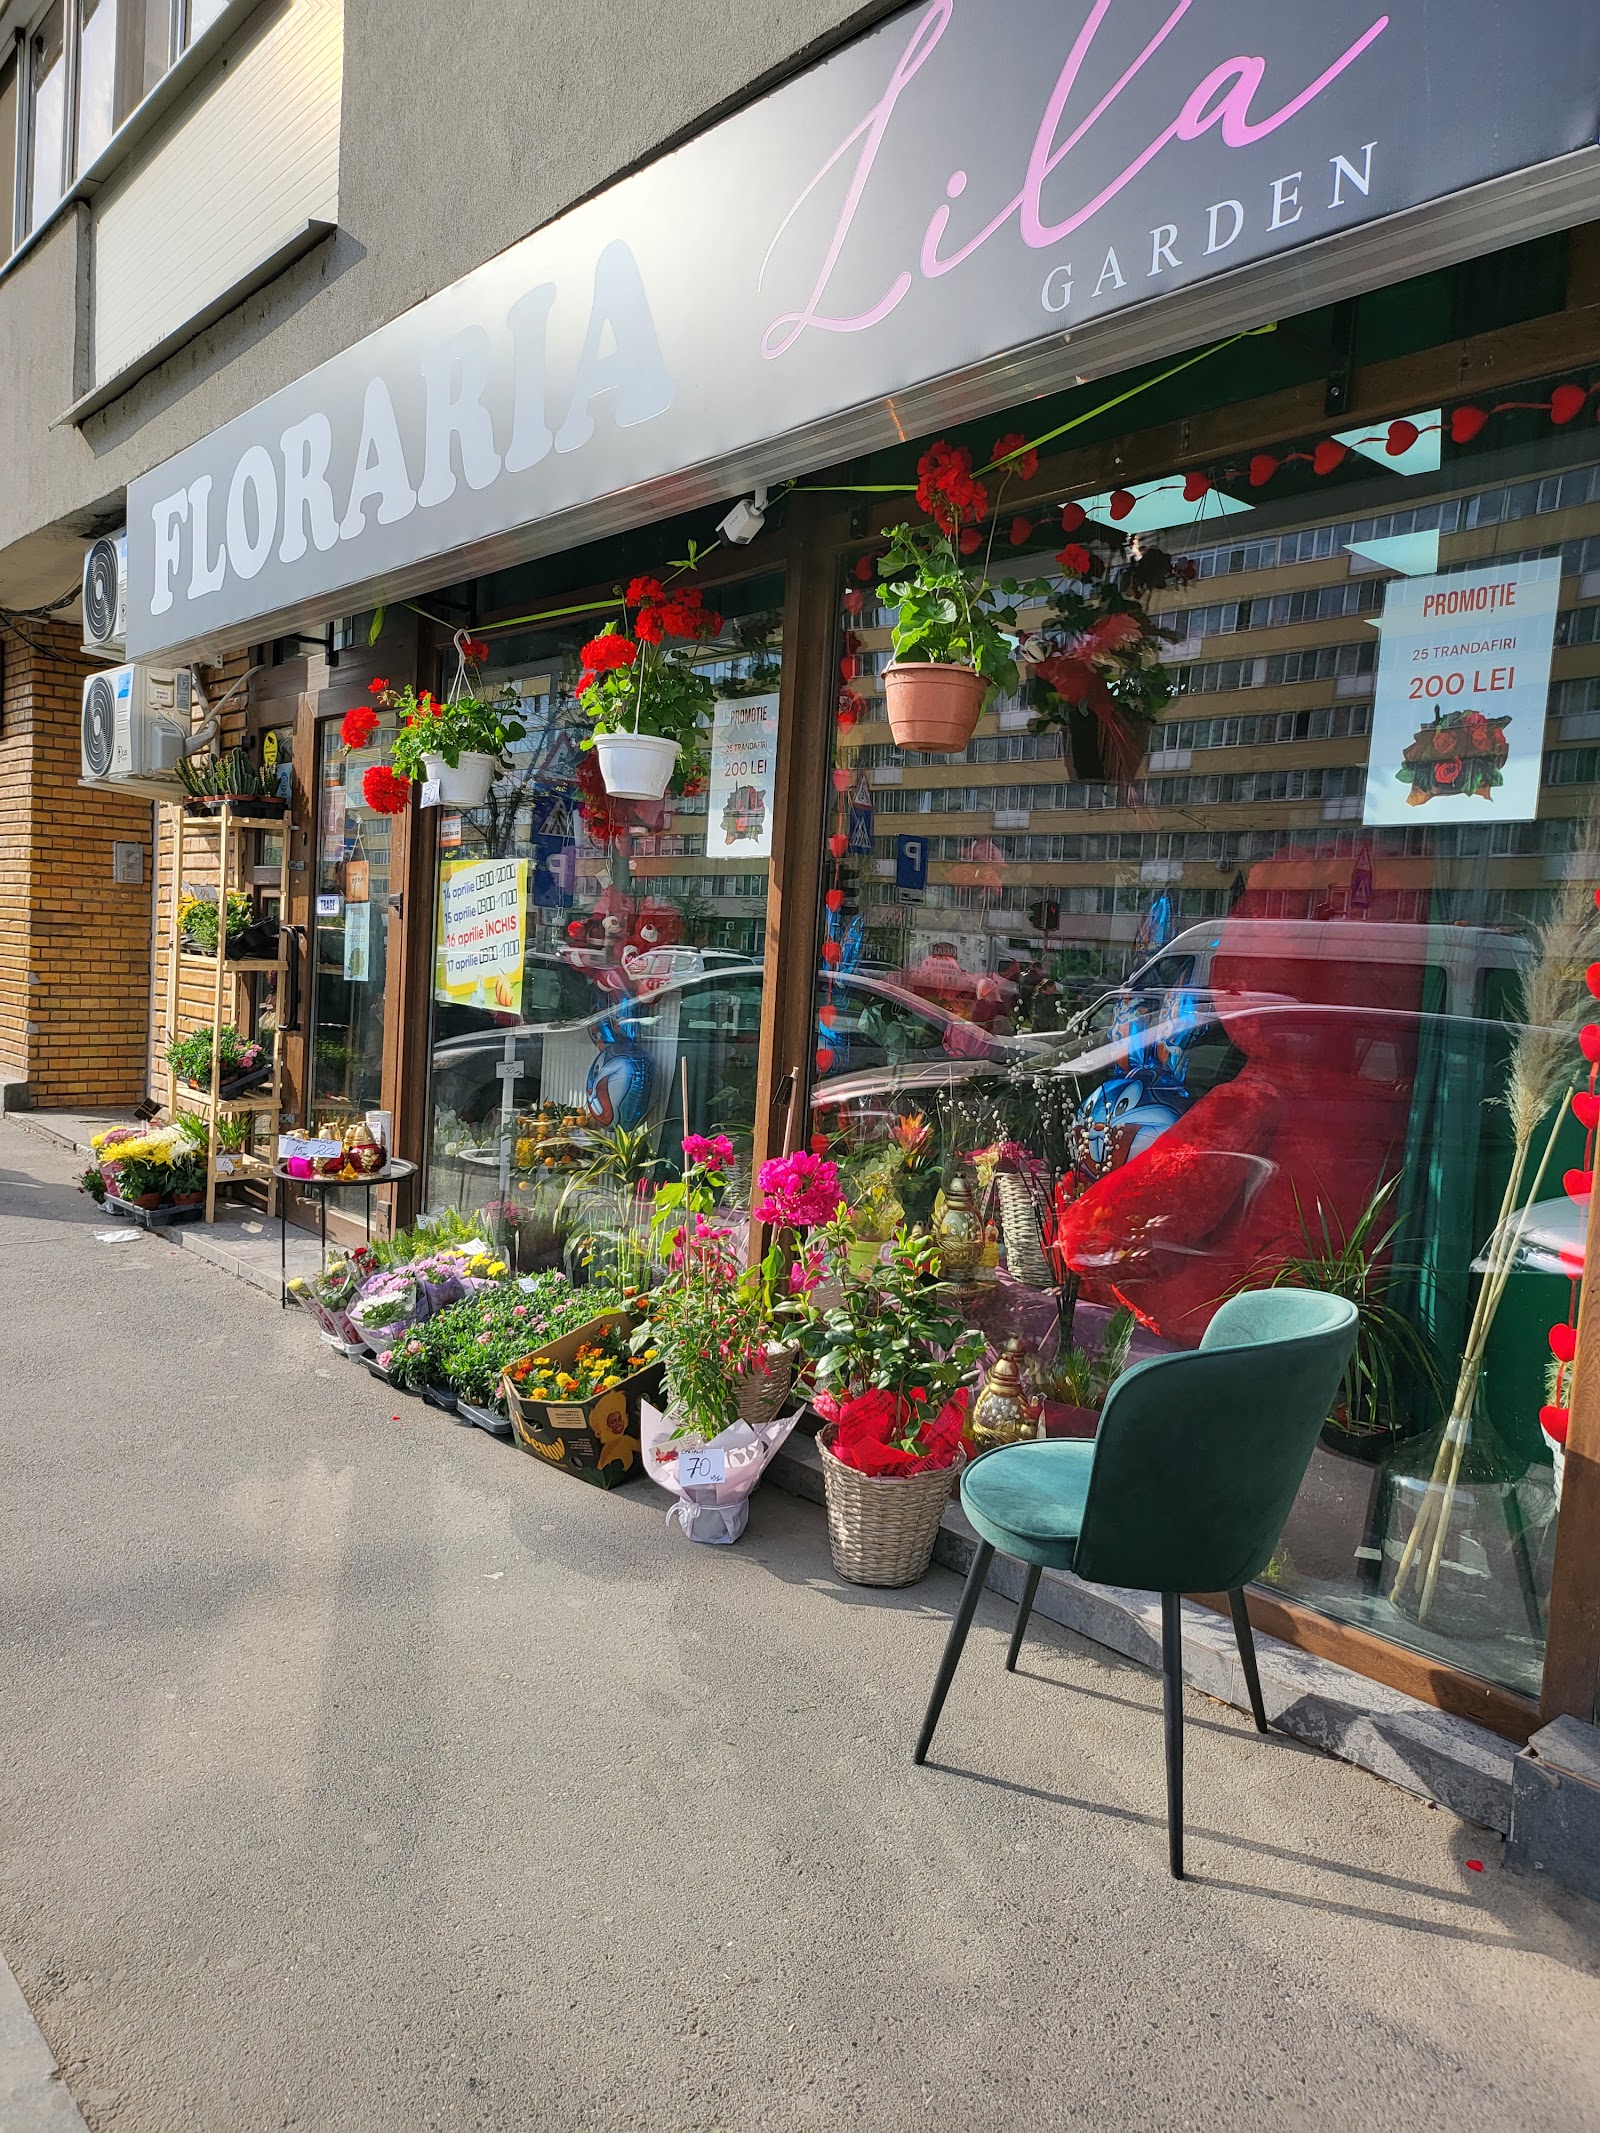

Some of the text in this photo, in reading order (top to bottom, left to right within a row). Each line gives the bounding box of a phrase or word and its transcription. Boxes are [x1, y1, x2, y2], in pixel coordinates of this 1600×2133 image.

[758, 0, 1389, 360] Lila
[1041, 140, 1379, 314] GARDEN
[150, 238, 674, 616] FLORARIA
[1423, 582, 1517, 617] PROMOȚIE
[1412, 637, 1516, 661] 25 TRANDAFIRI
[1408, 667, 1515, 700] 200 LEI
[726, 740, 768, 753] 25 TRANDAFIRI
[724, 759, 767, 777] 200 LEI
[443, 889, 451, 901] 14
[452, 882, 475, 900] aprilie
[445, 911, 452, 925] 15
[453, 905, 476, 924] aprilie
[447, 915, 517, 948] 16 aprilie ÎNCHIS
[447, 959, 454, 972] 17
[455, 953, 478, 972] aprilie
[686, 1457, 711, 1479] 70
